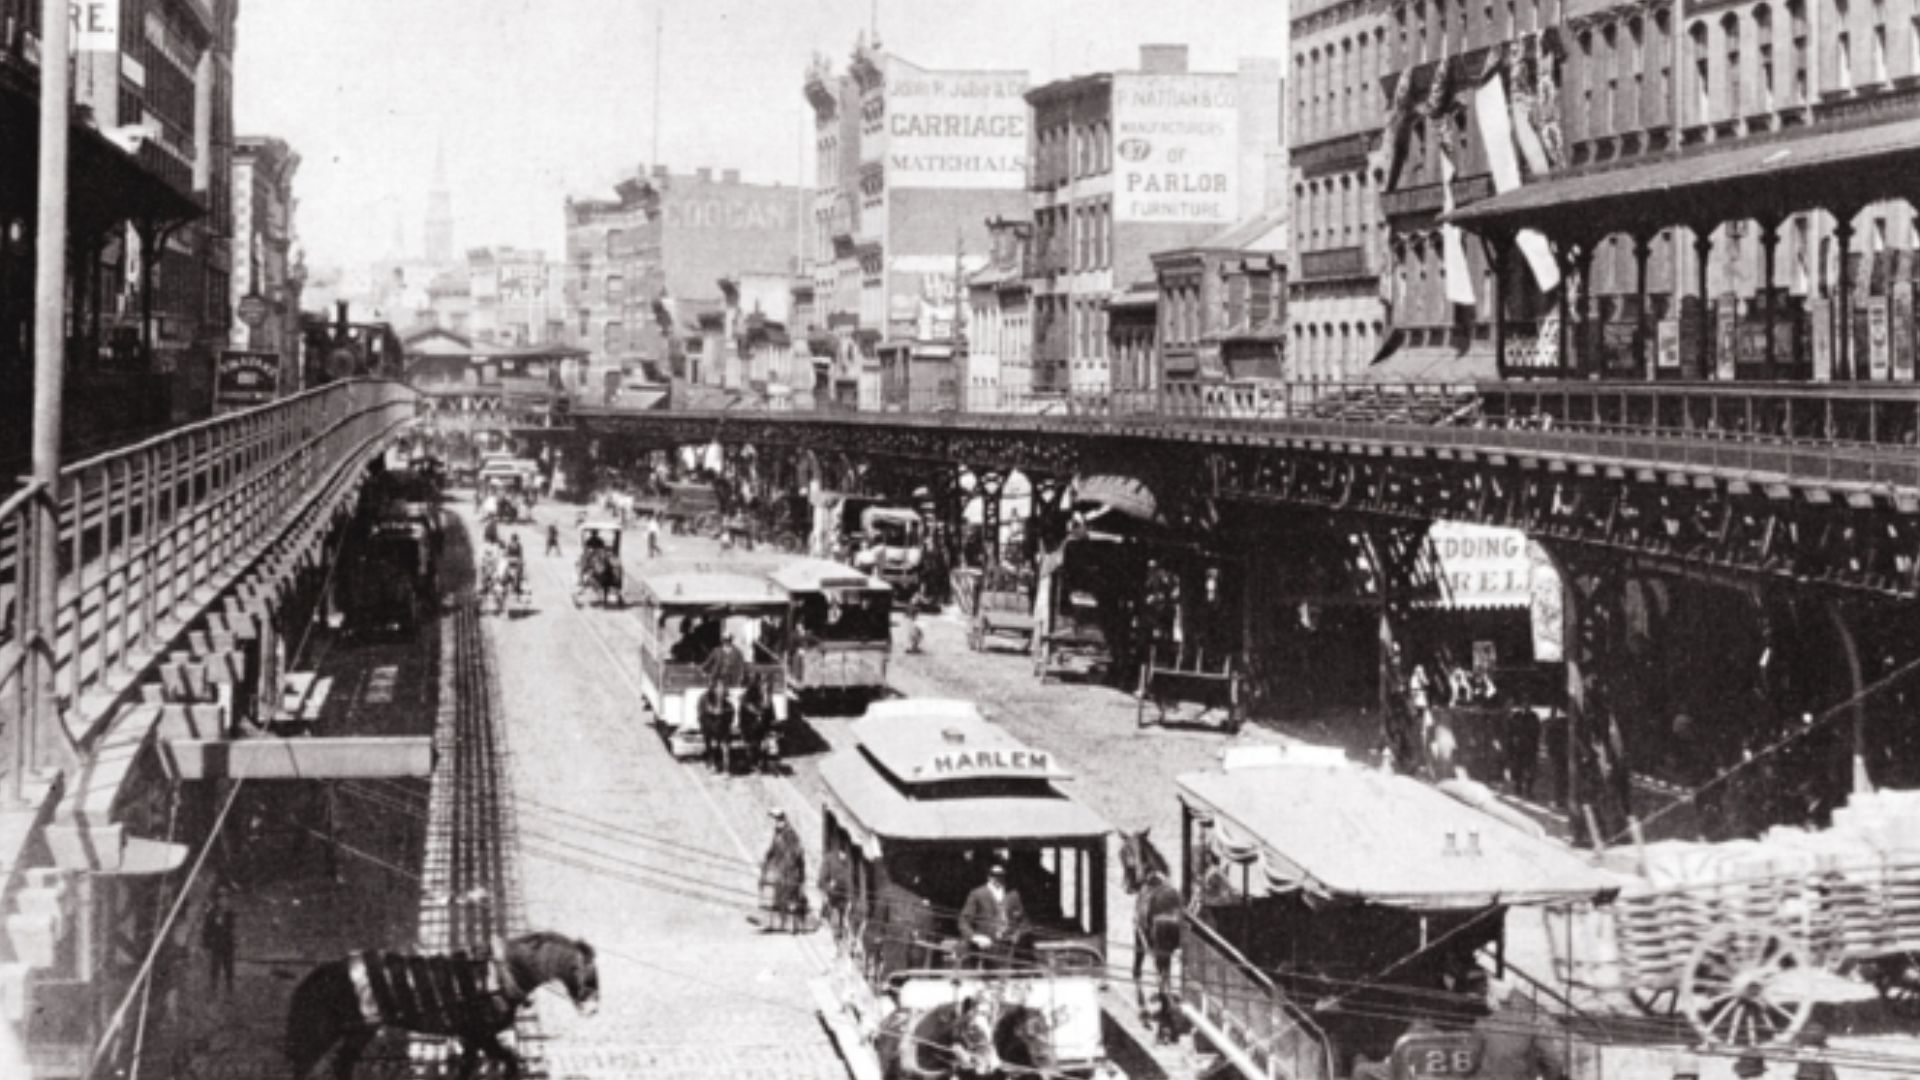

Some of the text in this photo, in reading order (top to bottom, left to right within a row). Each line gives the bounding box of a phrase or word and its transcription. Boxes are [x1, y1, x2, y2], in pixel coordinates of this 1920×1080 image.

[890, 113, 1024, 137] CARRIAGE
[890, 154, 1026, 172] MATERIALS
[1126, 173, 1228, 193] PARLOR
[934, 750, 1048, 772] HARLEM
